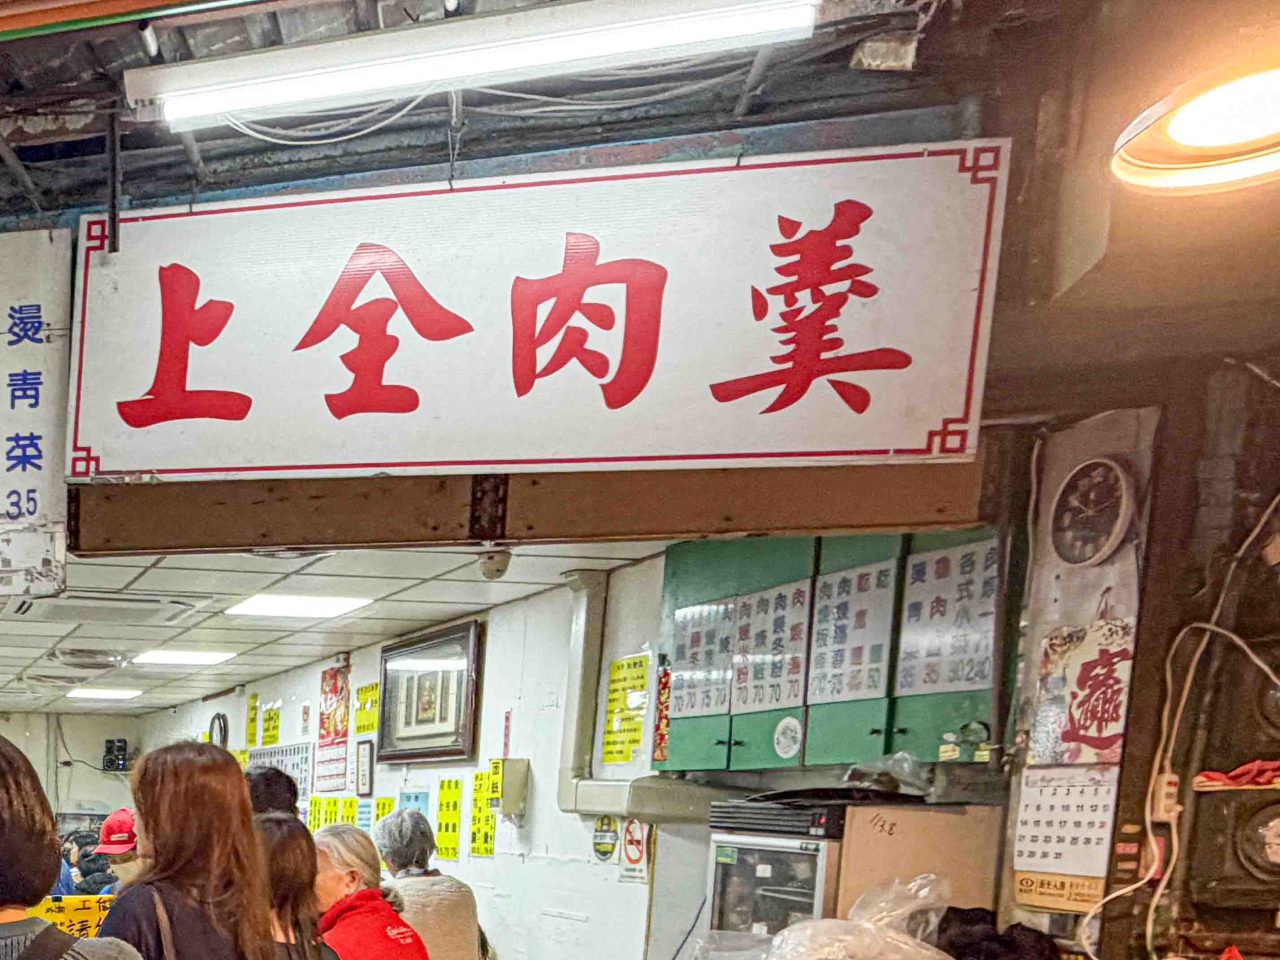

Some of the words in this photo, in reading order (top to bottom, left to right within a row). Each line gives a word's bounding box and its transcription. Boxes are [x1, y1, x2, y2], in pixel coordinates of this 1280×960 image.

[5, 304, 44, 472] 燙青菜
[117, 199, 912, 428] 上全肉羹
[5, 489, 37, 520] 35
